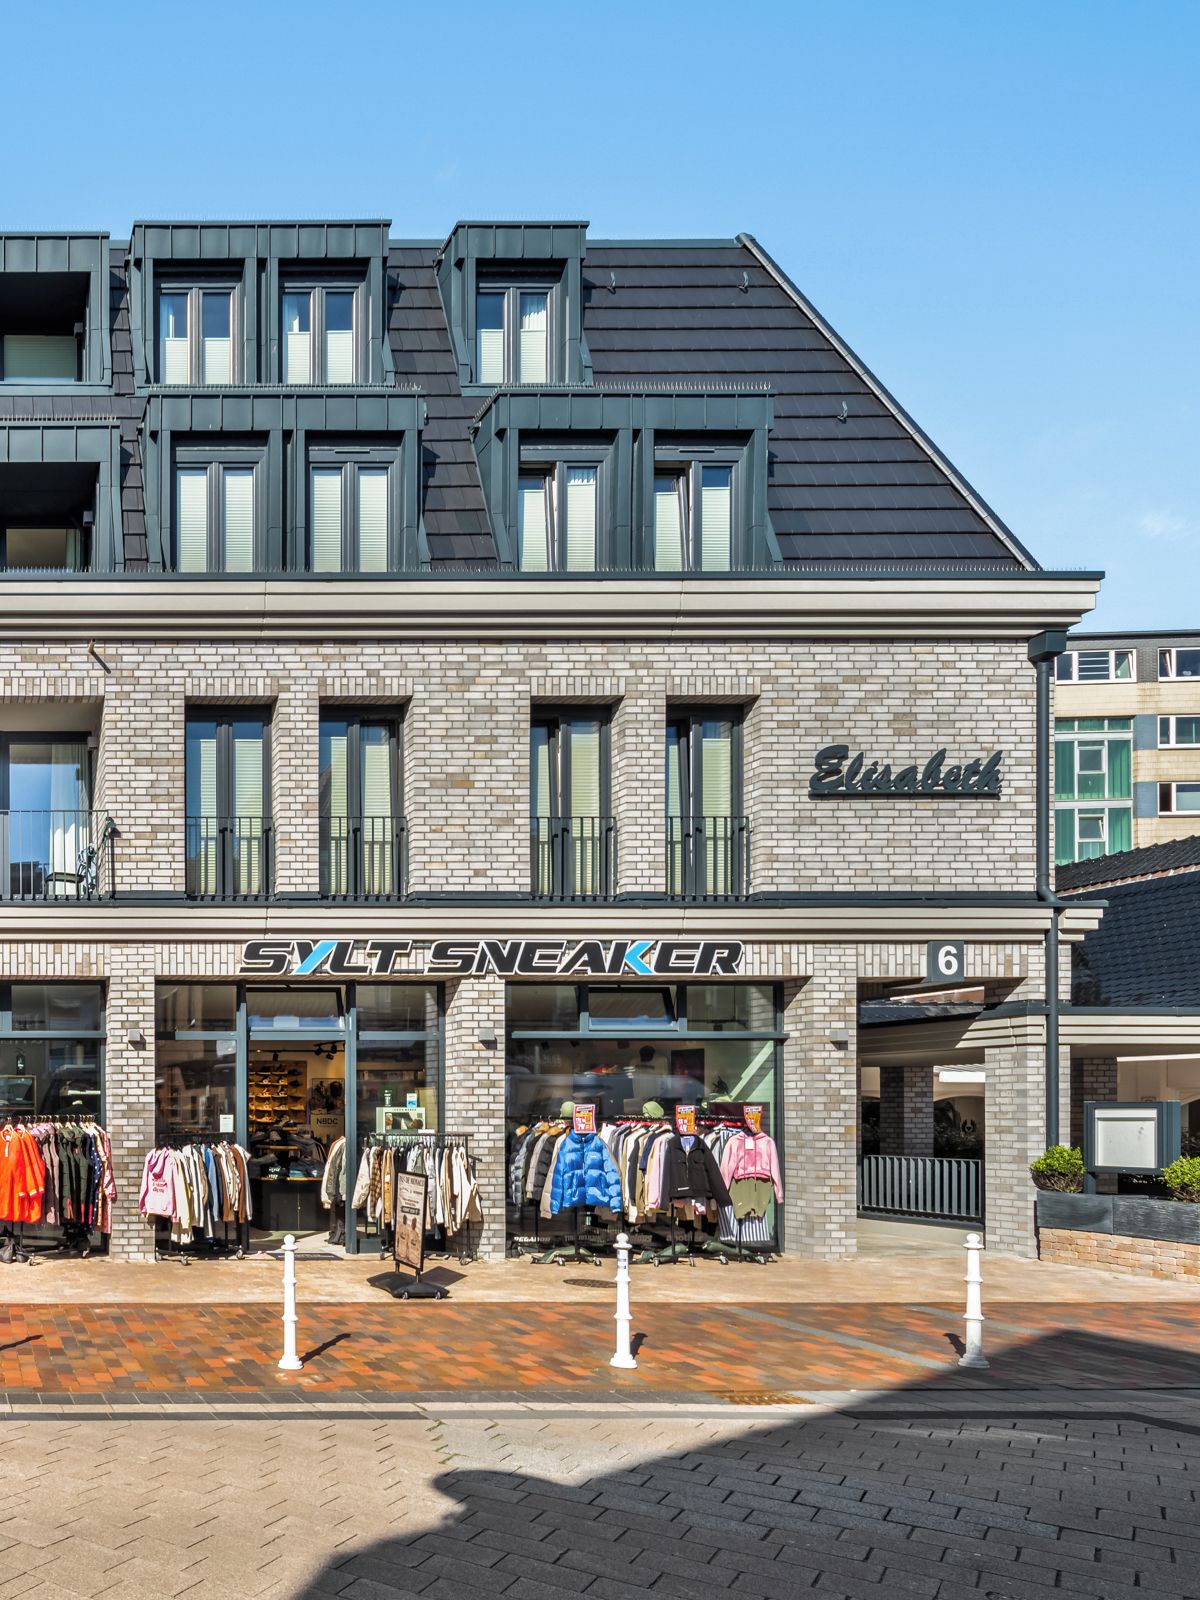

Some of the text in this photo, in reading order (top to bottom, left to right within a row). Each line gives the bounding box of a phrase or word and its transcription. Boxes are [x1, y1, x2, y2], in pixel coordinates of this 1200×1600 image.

[809, 744, 1003, 794] Elisabeth
[238, 938, 746, 976] SYLT SNEAKER
[937, 944, 959, 976] 6
